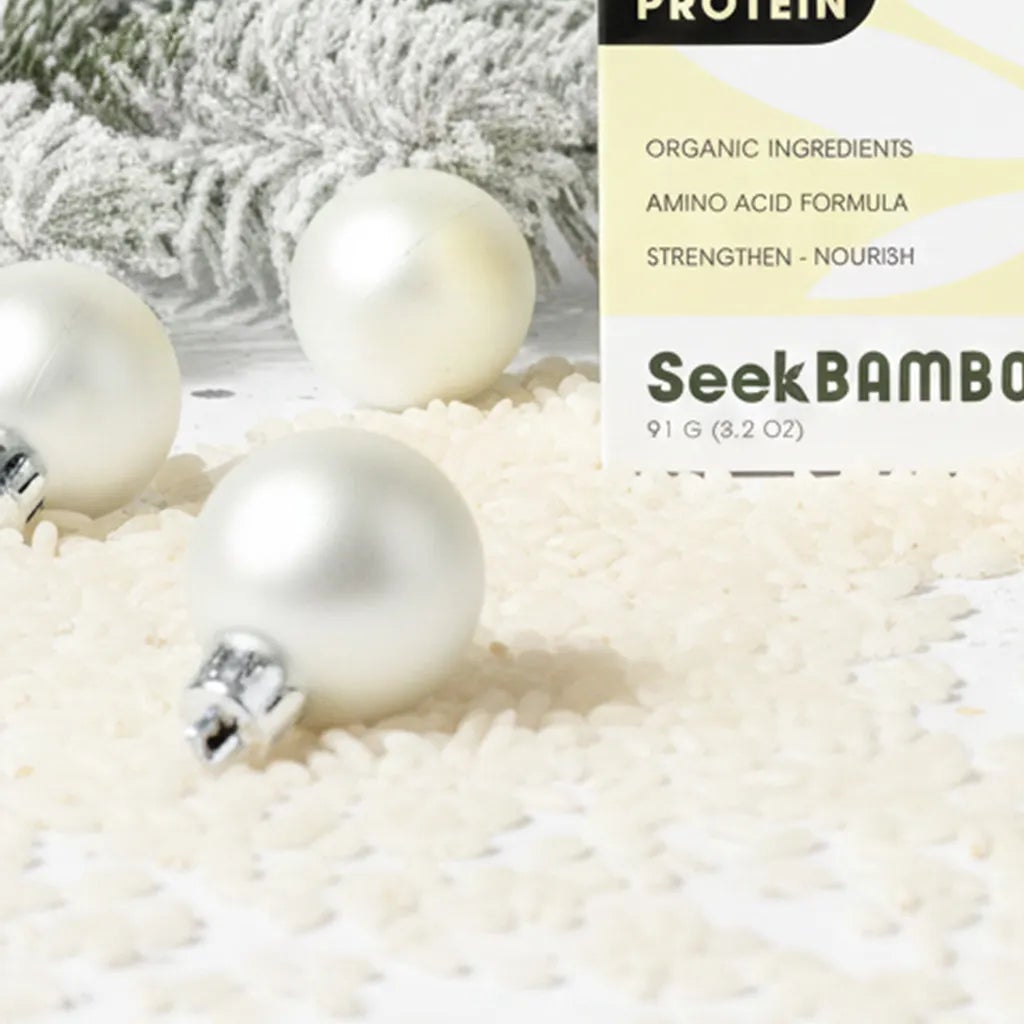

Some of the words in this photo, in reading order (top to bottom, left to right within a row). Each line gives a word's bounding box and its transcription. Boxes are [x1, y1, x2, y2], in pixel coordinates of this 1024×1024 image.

[645, 138, 759, 159] ORGANIC
[768, 138, 914, 159] INGREDIENTS
[646, 192, 727, 213] AMINO
[734, 192, 792, 213] ACID
[800, 192, 909, 213] FORMULA
[646, 246, 792, 267] STRENGTHEN
[814, 246, 915, 266] NOURISH
[647, 419, 672, 439] 91
[683, 419, 703, 439] G
[711, 419, 755, 444] (3.2
